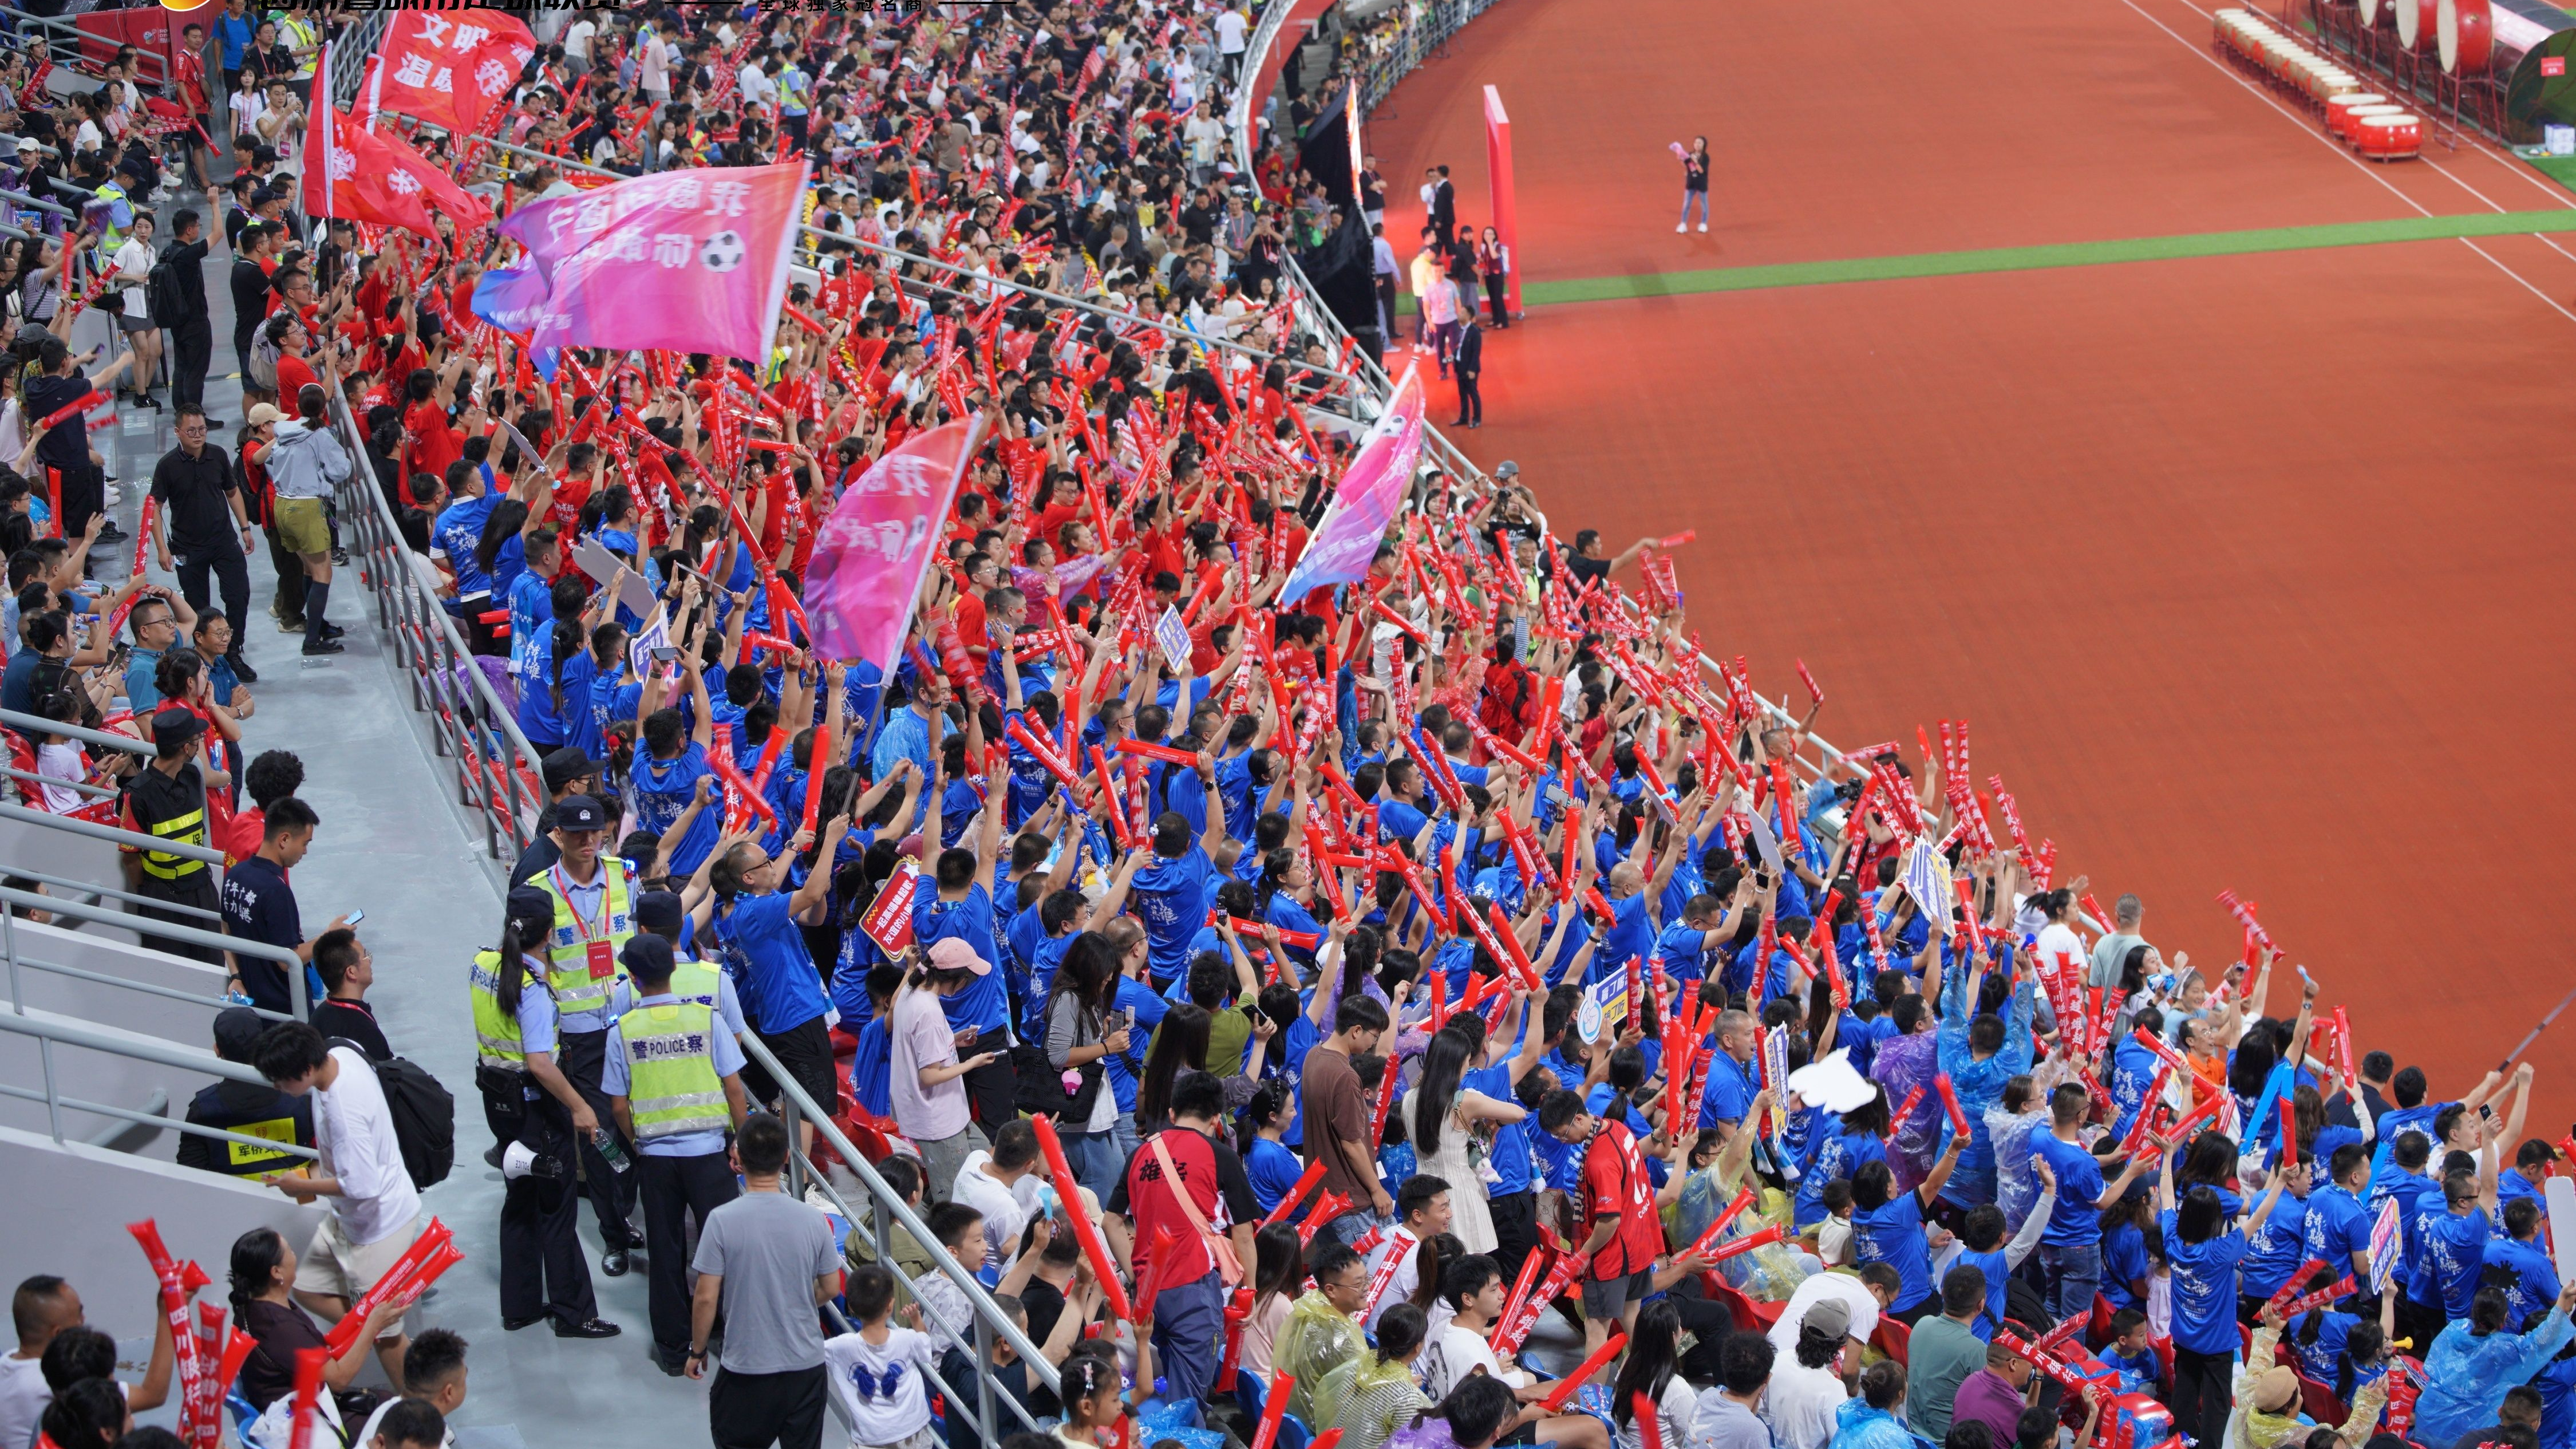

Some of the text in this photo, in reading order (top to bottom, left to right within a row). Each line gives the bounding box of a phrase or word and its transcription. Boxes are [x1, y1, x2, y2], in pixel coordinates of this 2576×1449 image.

[412, 12, 489, 54] 文明
[624, 462, 646, 508] 四川银行
[782, 466, 801, 515] 四川银行
[446, 524, 473, 539] 舍我
[1394, 676, 1406, 718] 四川银行
[1562, 738, 1599, 780] 川超雄起
[1998, 792, 2019, 838] 四川银行
[556, 914, 626, 946] 警 察
[1469, 909, 1511, 964] 川超雄起
[1867, 919, 1890, 972] 四川银行
[2054, 995, 2071, 1039] 川超雄起
[2069, 987, 2084, 1045] 川超雄起
[2092, 1008, 2119, 1059] 川超雄起
[632, 1035, 703, 1060] 警 POLICE 察
[1686, 1074, 1708, 1123] 四川银行
[2305, 1206, 2324, 1227] 舍我
[2308, 1227, 2326, 1251] 其谁
[2250, 1231, 2276, 1255] 其谁
[367, 1257, 415, 1304] 四川省城市足球联赛
[1509, 1280, 1560, 1349] 川超雄起
[170, 1305, 201, 1407] 四川银行
[2021, 1343, 2080, 1384] 四川银行
